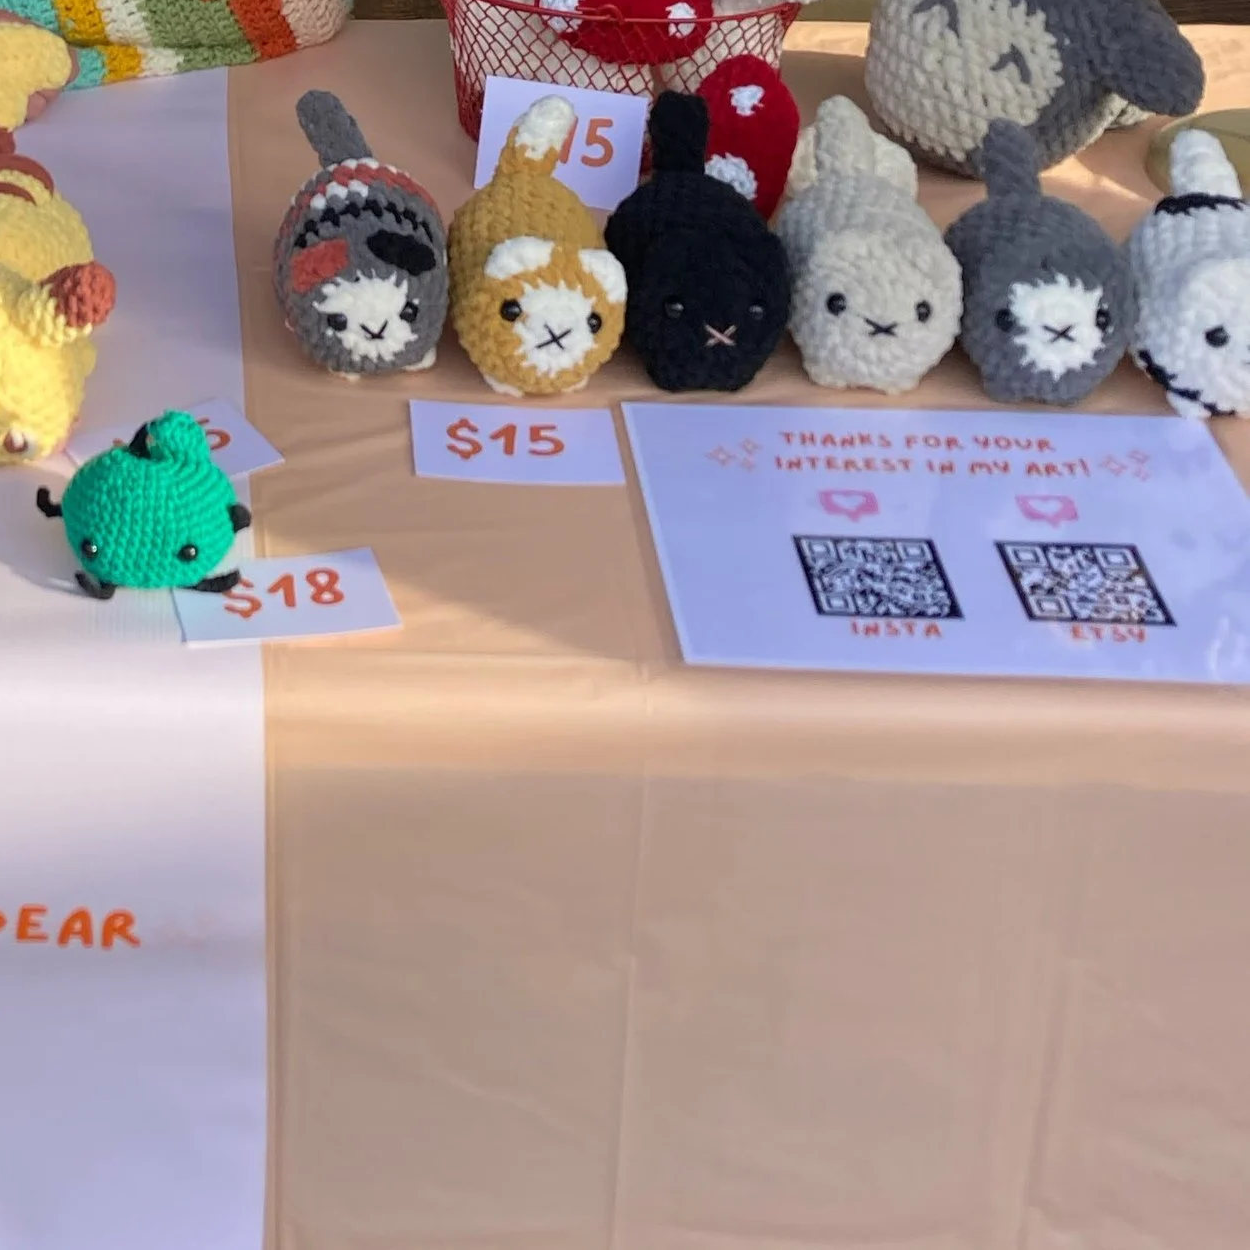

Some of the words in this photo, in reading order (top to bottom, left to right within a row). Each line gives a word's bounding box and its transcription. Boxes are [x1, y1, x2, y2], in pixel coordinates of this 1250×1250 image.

[446, 418, 564, 460] $15
[780, 431, 892, 448] THANKS
[905, 435, 963, 450] FOR
[973, 436, 1056, 452] YOUR
[775, 455, 913, 472] INTEREST
[926, 460, 955, 474] IN
[969, 461, 1010, 475] MY
[1026, 458, 1090, 477] ART!
[223, 568, 344, 619] $18
[851, 621, 943, 638] INSTA
[1070, 624, 1146, 643] ETSY
